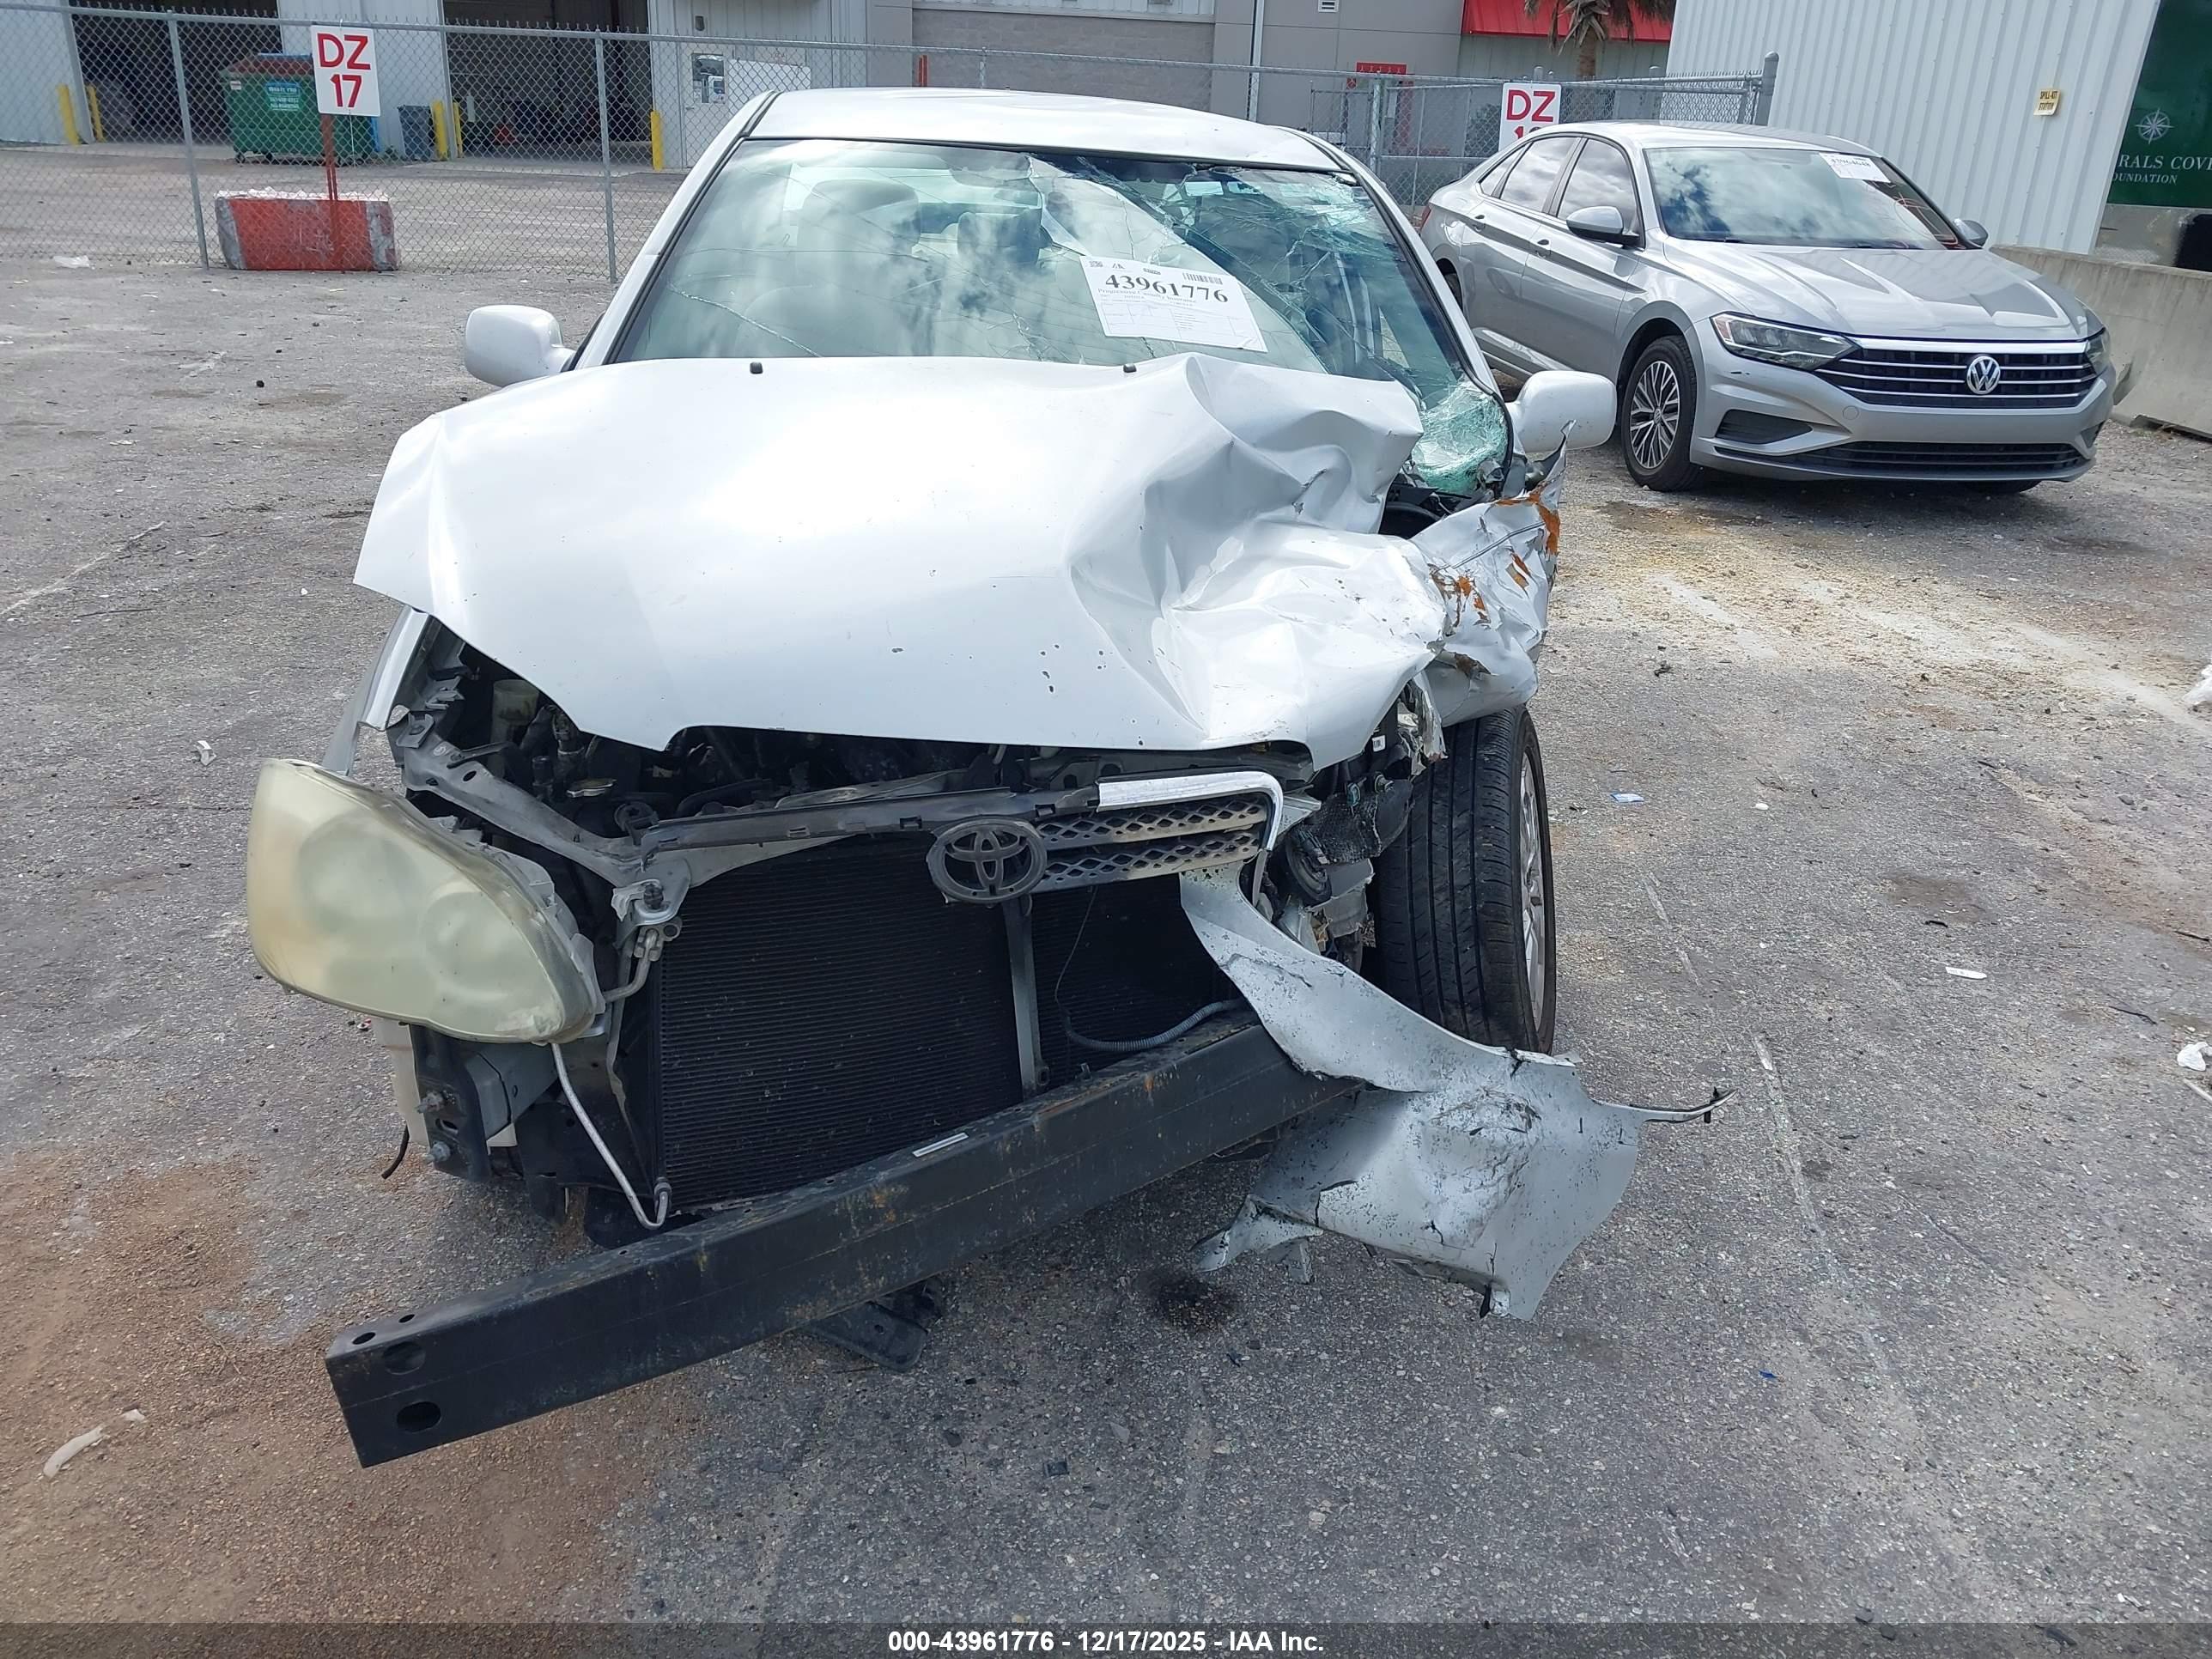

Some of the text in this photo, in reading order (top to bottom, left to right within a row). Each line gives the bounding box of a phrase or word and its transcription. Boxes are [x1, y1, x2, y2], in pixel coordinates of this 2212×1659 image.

[317, 33, 372, 70] DZ
[330, 74, 362, 107] 17
[1506, 89, 1556, 122] DZ
[1105, 274, 1229, 303] 43961776
